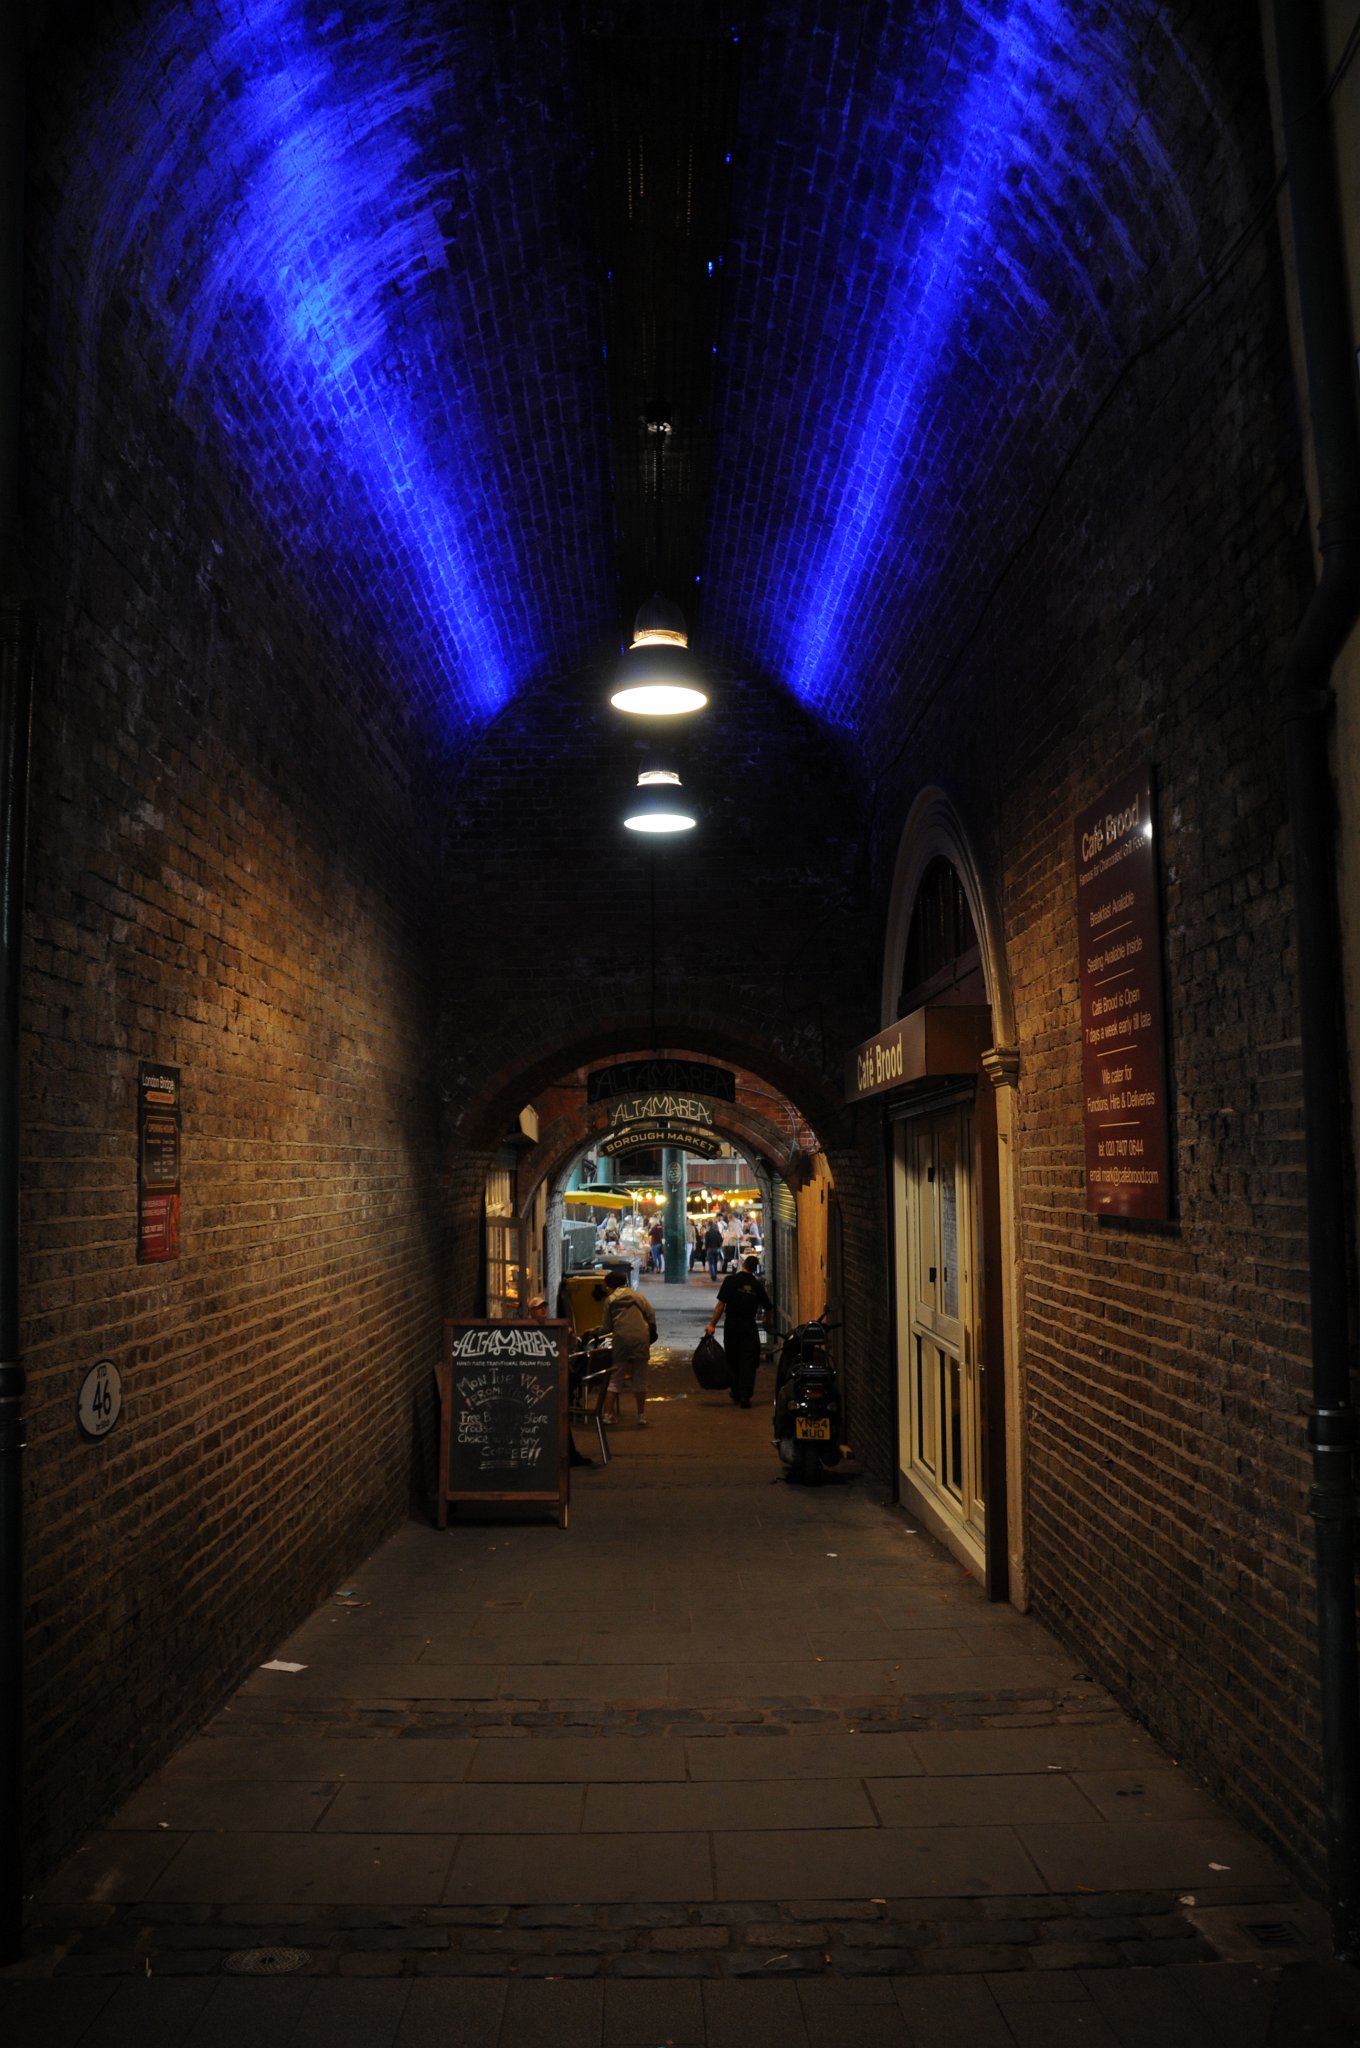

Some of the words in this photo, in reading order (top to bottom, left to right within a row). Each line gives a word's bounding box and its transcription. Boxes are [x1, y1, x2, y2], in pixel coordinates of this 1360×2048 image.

[1081, 819, 1104, 862] Café
[1105, 793, 1139, 846] Brood
[1112, 888, 1135, 914] Available
[1087, 955, 1104, 974] Seating
[1104, 943, 1126, 966] Available
[1126, 935, 1143, 956] Inside
[1091, 998, 1103, 1017] Café
[1103, 991, 1118, 1013] Brood
[1118, 992, 1124, 1007] is
[1124, 988, 1140, 1008] Open
[1089, 1026, 1100, 1045] days
[1104, 1018, 1119, 1038] week
[1118, 1015, 1133, 1036] early
[1140, 1010, 1152, 1028] late
[857, 1047, 874, 1091] Café
[875, 1032, 903, 1084] Brood
[1101, 1067, 1110, 1085] We
[1110, 1067, 1124, 1083] cater
[1124, 1063, 1133, 1080] for
[142, 1073, 159, 1089] London
[159, 1074, 175, 1094] Bridge
[591, 1062, 734, 1101] ALTAMAREA
[611, 1095, 713, 1127] ALTAMAREA
[1109, 1092, 1121, 1110] Hire
[1121, 1091, 1127, 1108] &
[1127, 1088, 1156, 1108] Deliveries
[606, 1131, 665, 1153] BOROUGH
[667, 1132, 715, 1151] MARKET
[451, 1329, 560, 1358] ALTAMAREA
[92, 1380, 111, 1419] 46
[460, 1411, 481, 1423] Free
[458, 1433, 489, 1444] Choice
